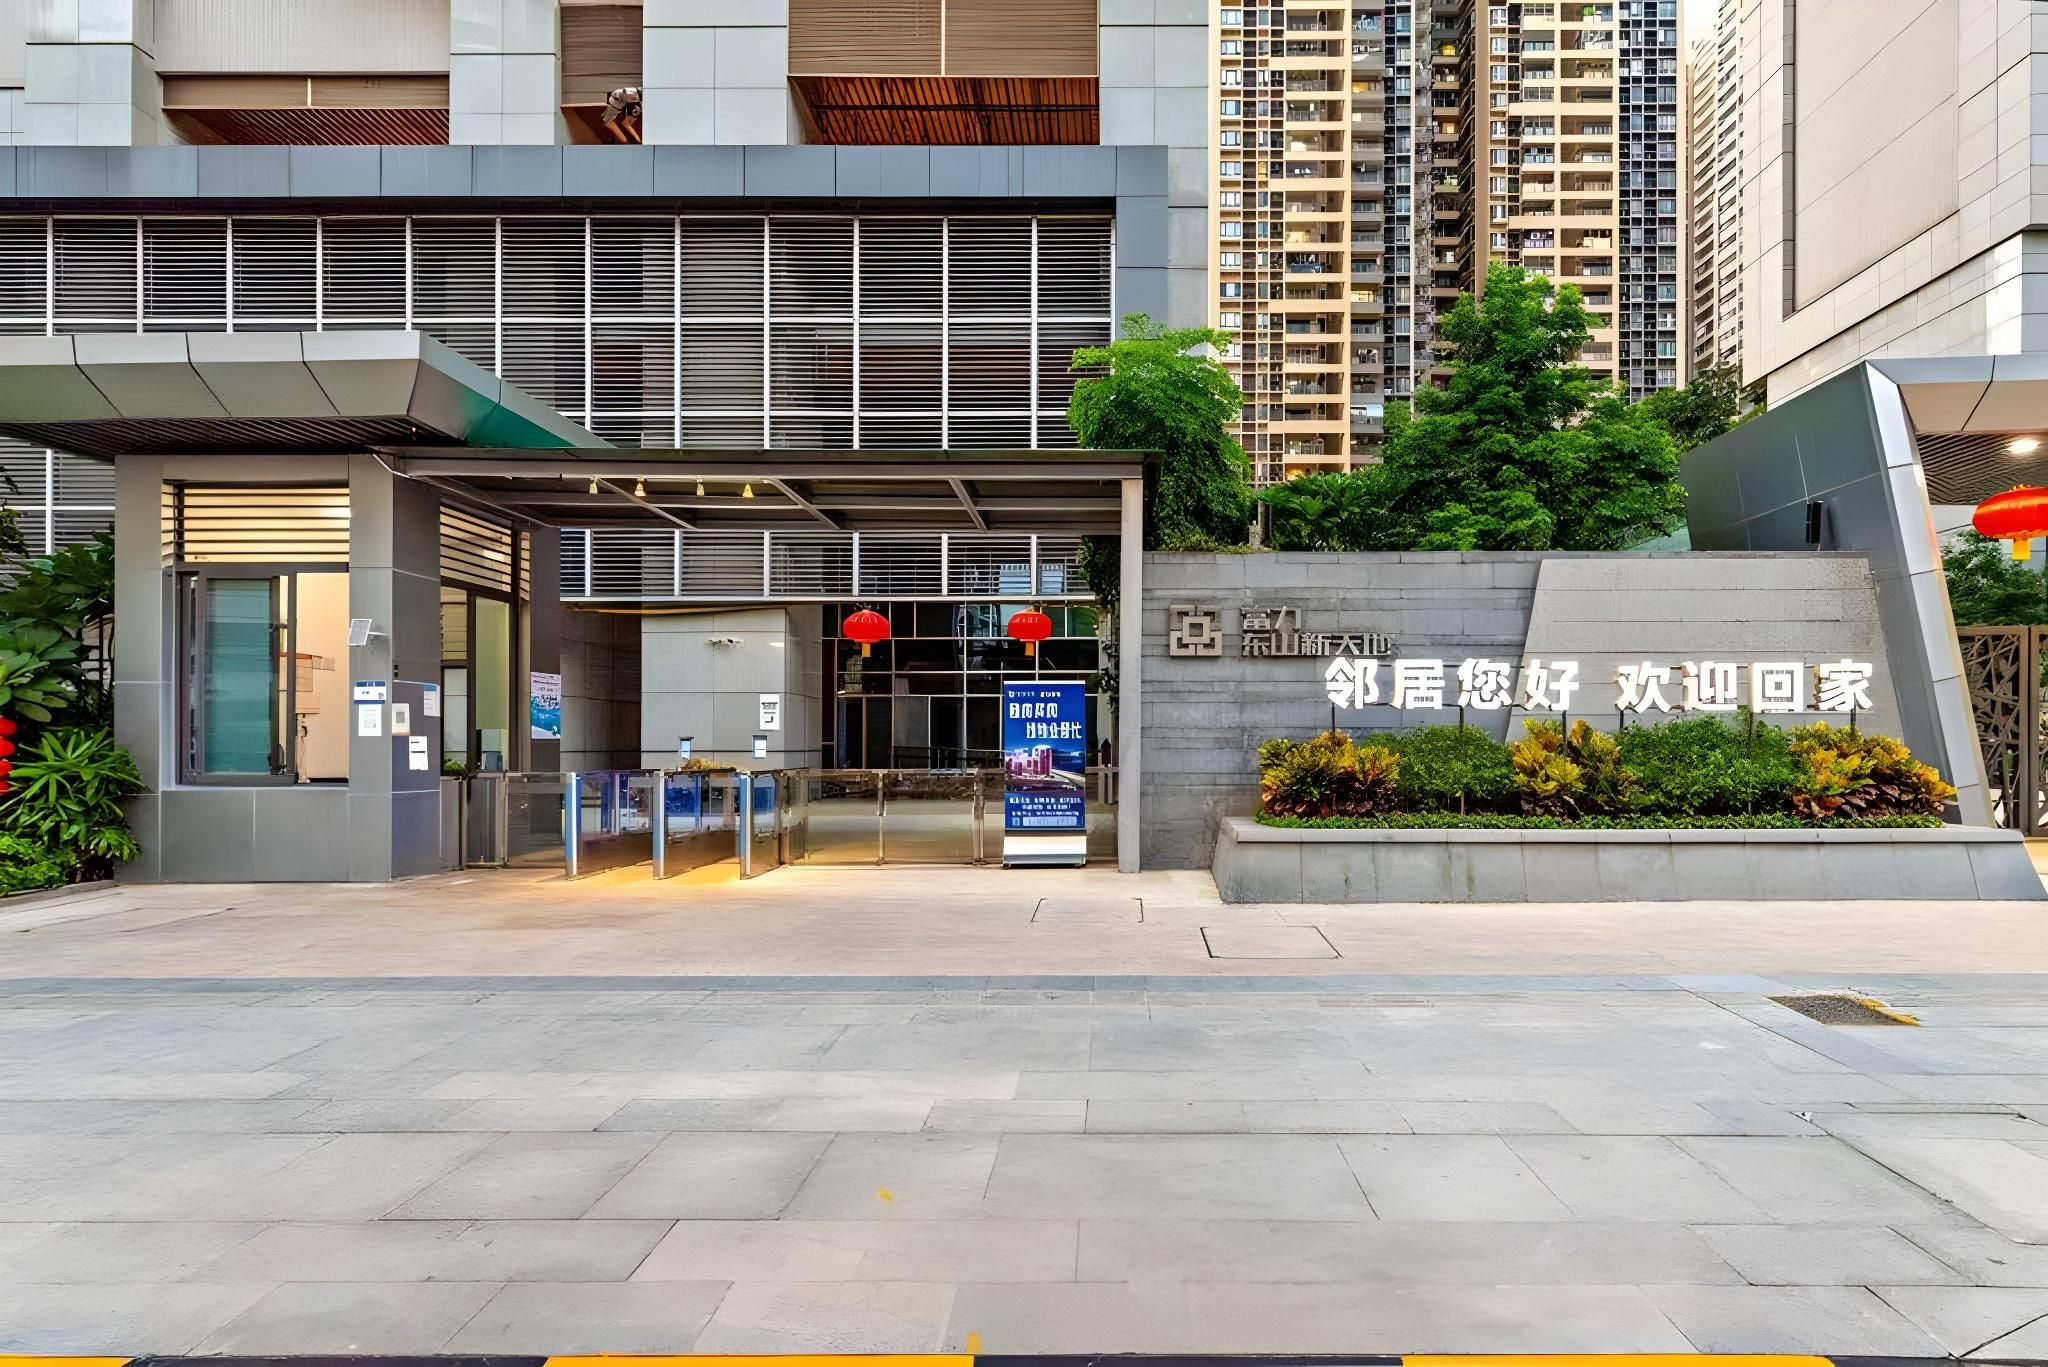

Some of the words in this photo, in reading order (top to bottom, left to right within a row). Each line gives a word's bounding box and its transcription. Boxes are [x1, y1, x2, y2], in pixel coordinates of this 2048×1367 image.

[1325, 657, 1580, 711] 邻居您好
[1614, 659, 1873, 713] 欢迎回家
